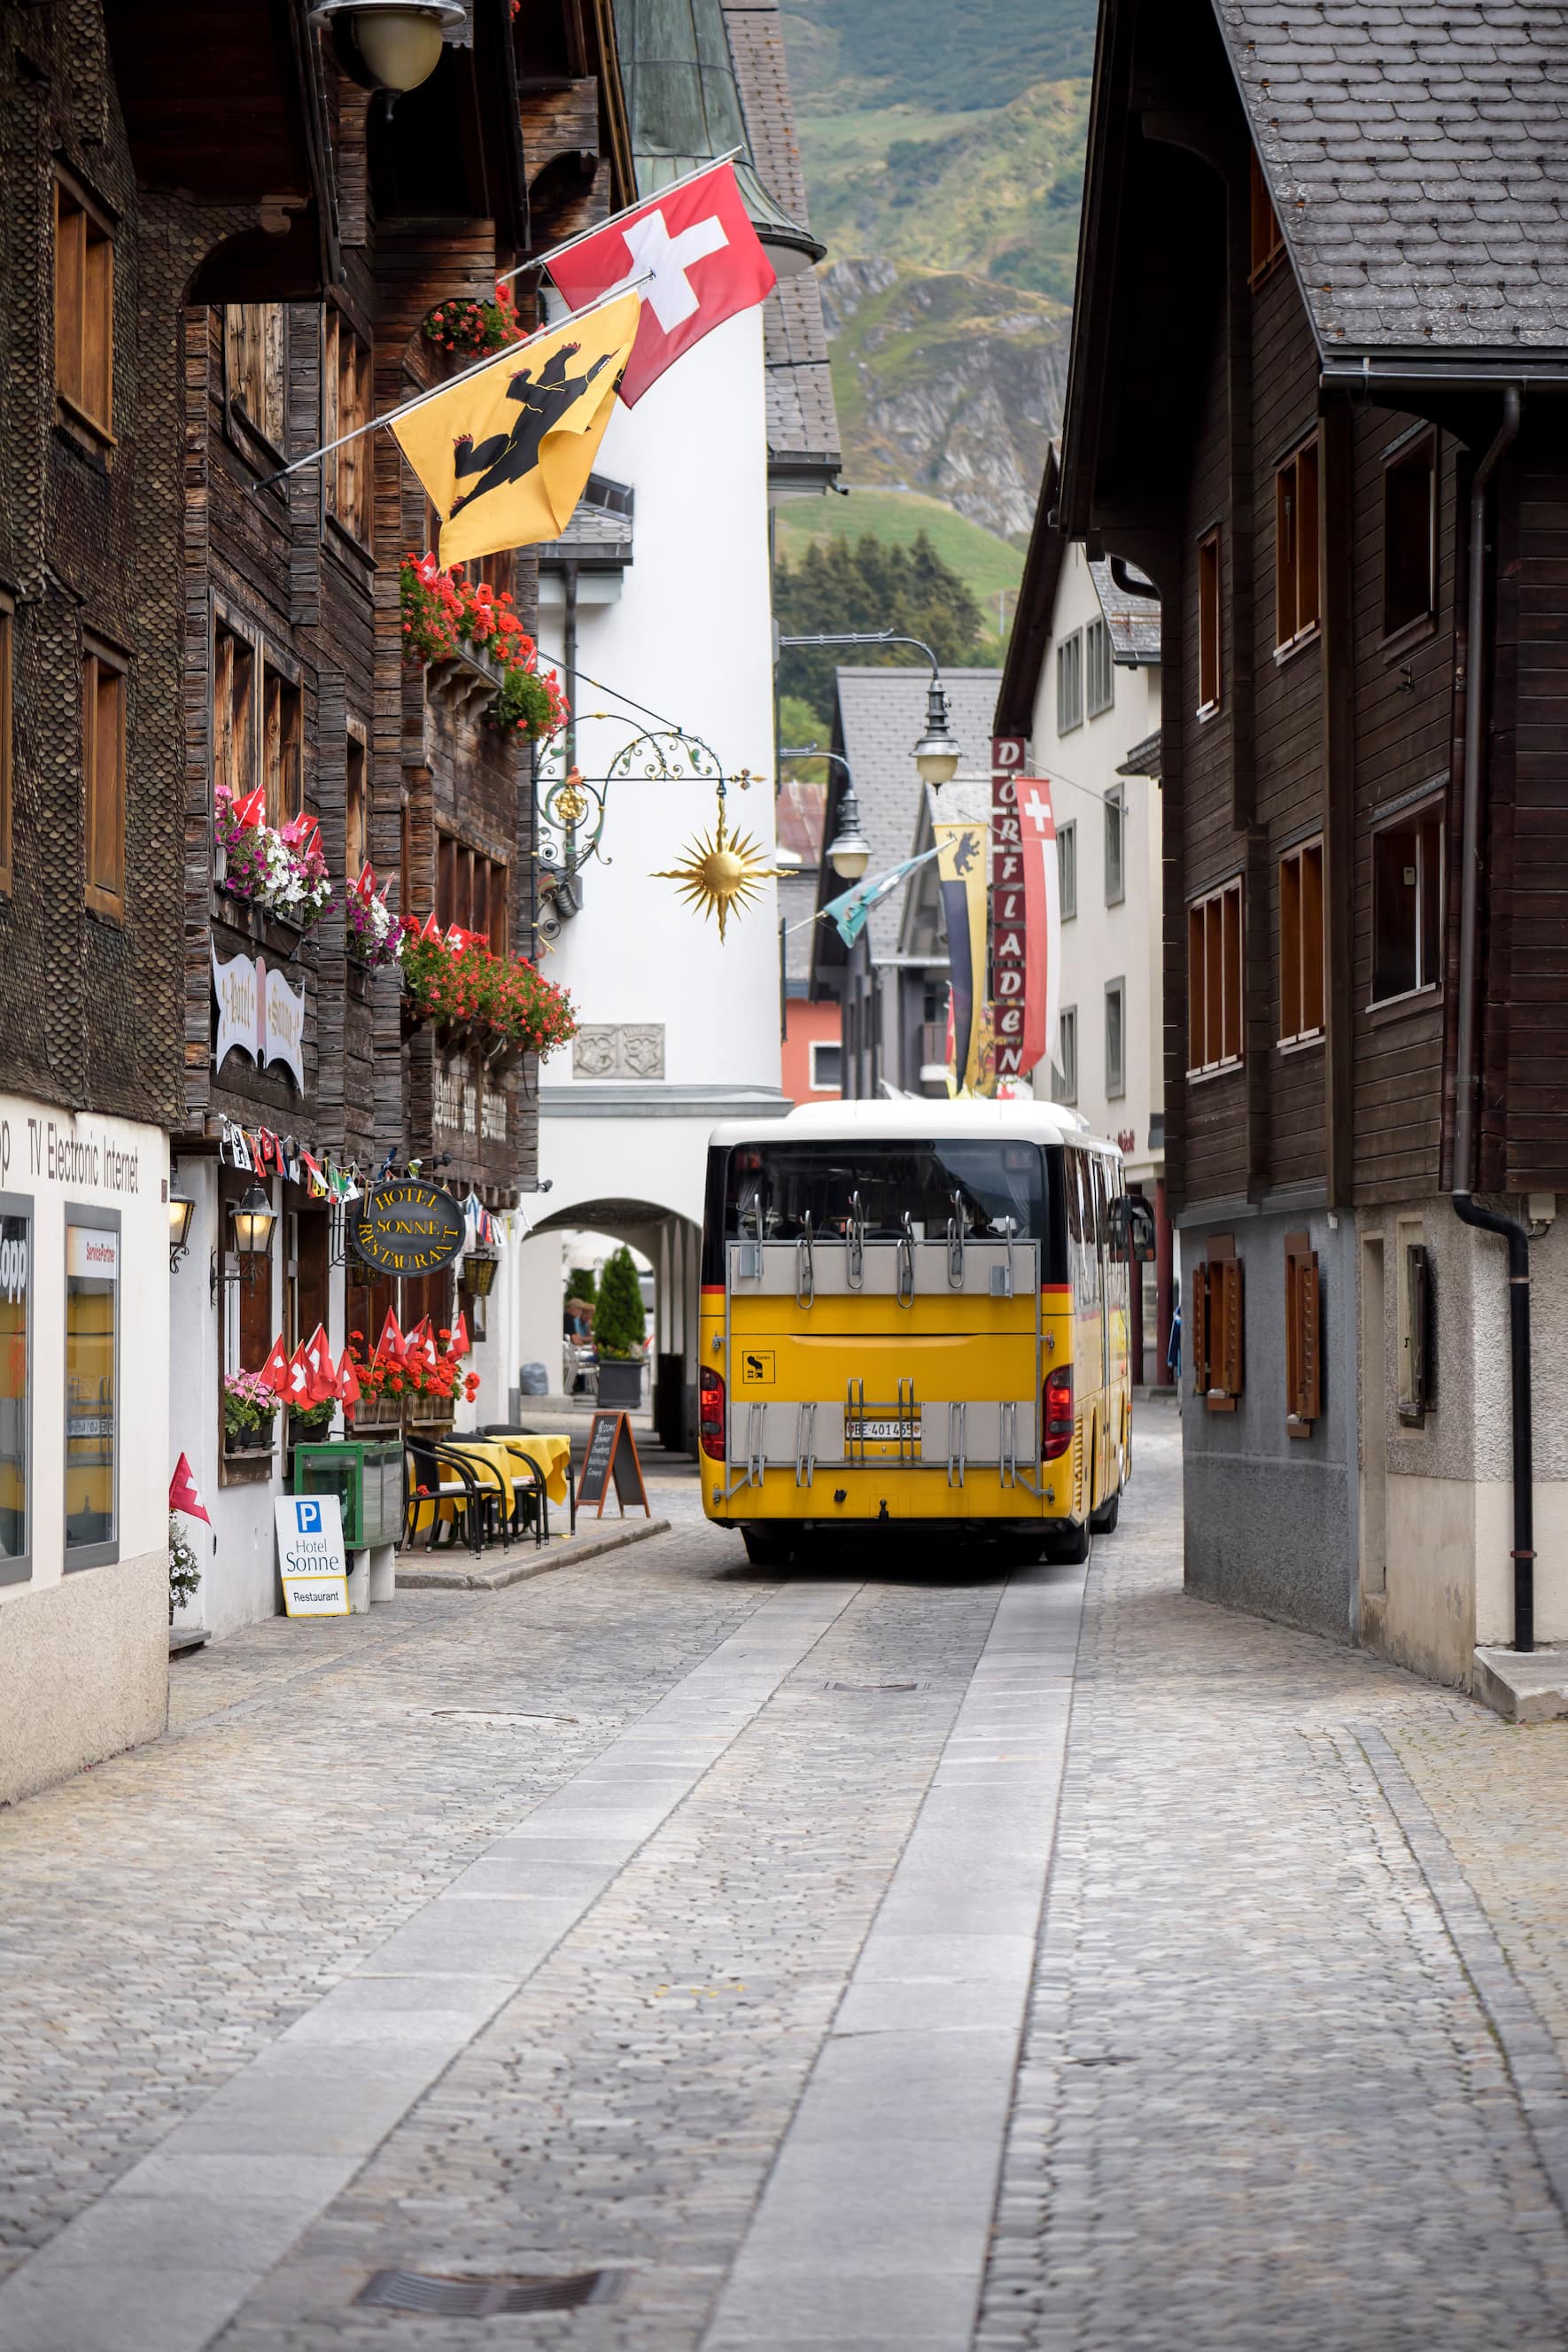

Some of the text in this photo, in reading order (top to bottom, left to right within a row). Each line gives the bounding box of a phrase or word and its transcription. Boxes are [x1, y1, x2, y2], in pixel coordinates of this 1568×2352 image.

[28, 1118, 42, 1176] TV
[48, 1122, 98, 1186] Electronic
[104, 1135, 139, 1194] Internet
[375, 1188, 439, 1211] HOTEL
[376, 1219, 440, 1235] SONNE
[359, 1223, 459, 1269] RESTAURANT
[299, 1502, 317, 1531] P
[296, 1539, 327, 1553] Hotel
[286, 1552, 339, 1572] Sonne
[293, 1592, 339, 1602] Restaurant
